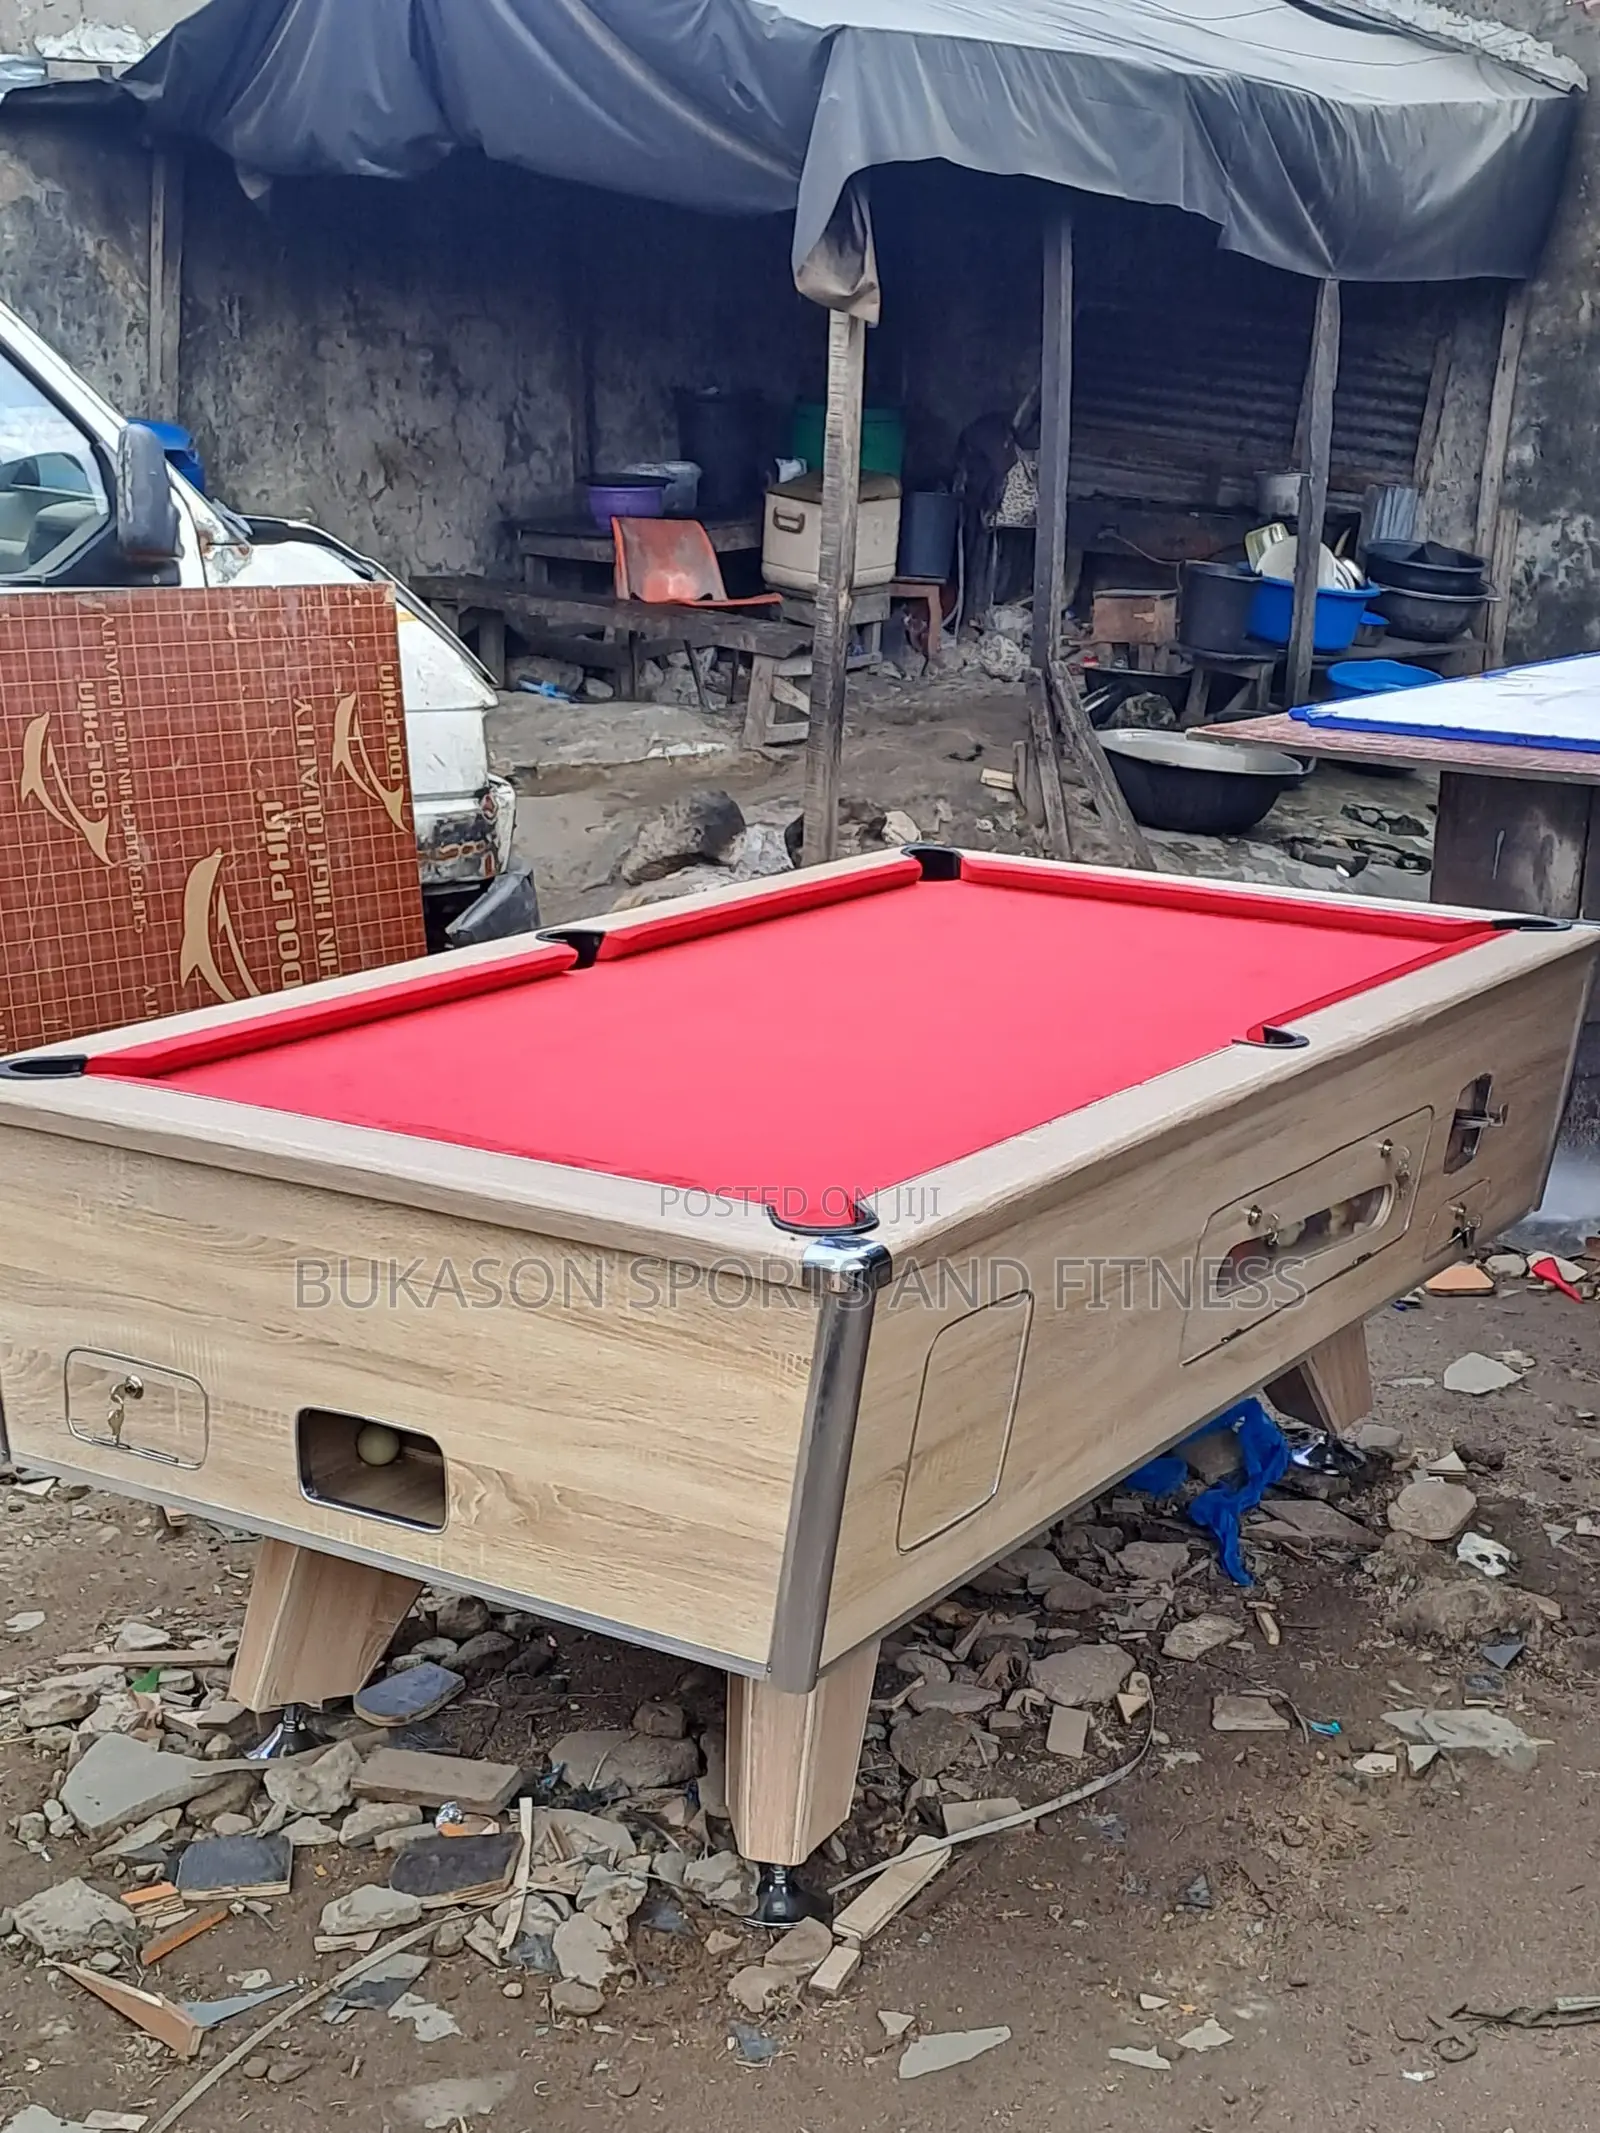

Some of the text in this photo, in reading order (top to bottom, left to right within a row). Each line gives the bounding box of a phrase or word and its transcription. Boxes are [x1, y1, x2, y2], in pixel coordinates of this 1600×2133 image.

[100, 614, 124, 706] QUALITY
[78, 682, 109, 810] DOLPHIN
[293, 698, 325, 834] QUALITY
[379, 664, 404, 780] DOLPHIN
[128, 865, 148, 934] SUPER
[308, 842, 334, 920] HIGH
